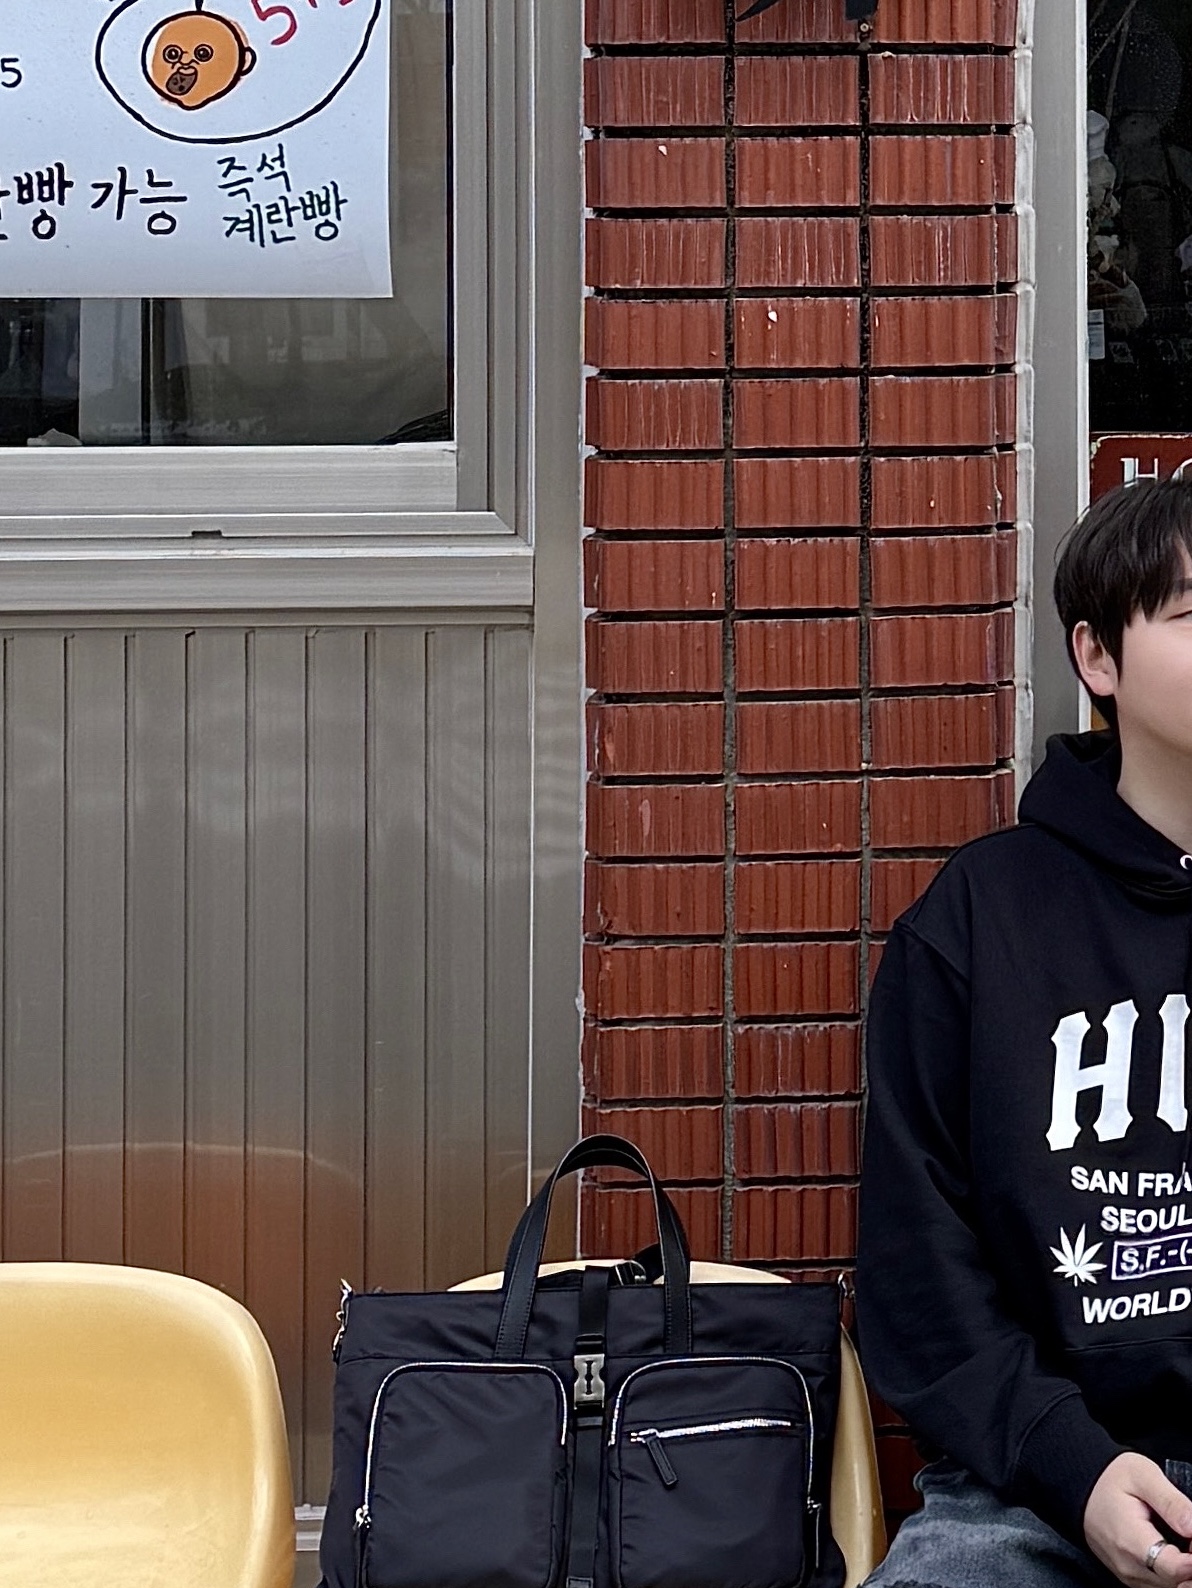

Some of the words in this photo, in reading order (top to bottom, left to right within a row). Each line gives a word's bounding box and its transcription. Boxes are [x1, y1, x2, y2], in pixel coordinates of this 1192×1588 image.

[91, 166, 188, 236] 가능
[217, 144, 292, 201] 즉석
[222, 181, 348, 249] 계란빵
[1070, 1165, 1129, 1196] SAN
